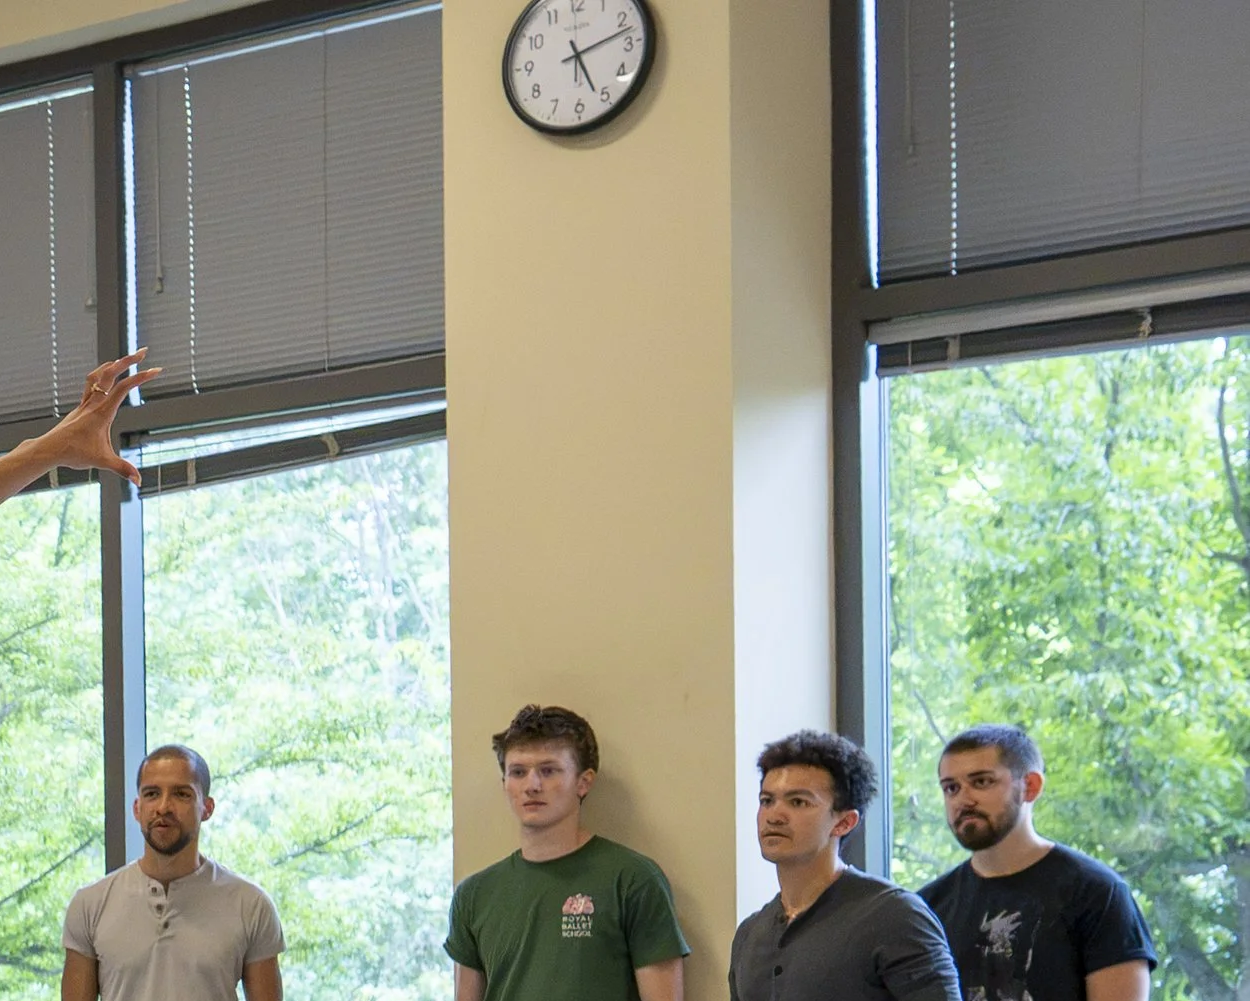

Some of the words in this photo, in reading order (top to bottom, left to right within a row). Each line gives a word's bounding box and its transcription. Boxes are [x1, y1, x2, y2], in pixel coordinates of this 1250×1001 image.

[570, 0, 585, 12] 12
[546, 9, 558, 25] 11
[617, 12, 627, 28] 2
[529, 33, 544, 50] 10
[623, 36, 634, 52] 3
[524, 61, 534, 77] 9
[616, 62, 627, 77] 4
[531, 83, 541, 99] 8
[600, 86, 610, 102] 5
[550, 99, 559, 115] 7
[574, 98, 585, 114] 6
[561, 922, 591, 930] BALLET
